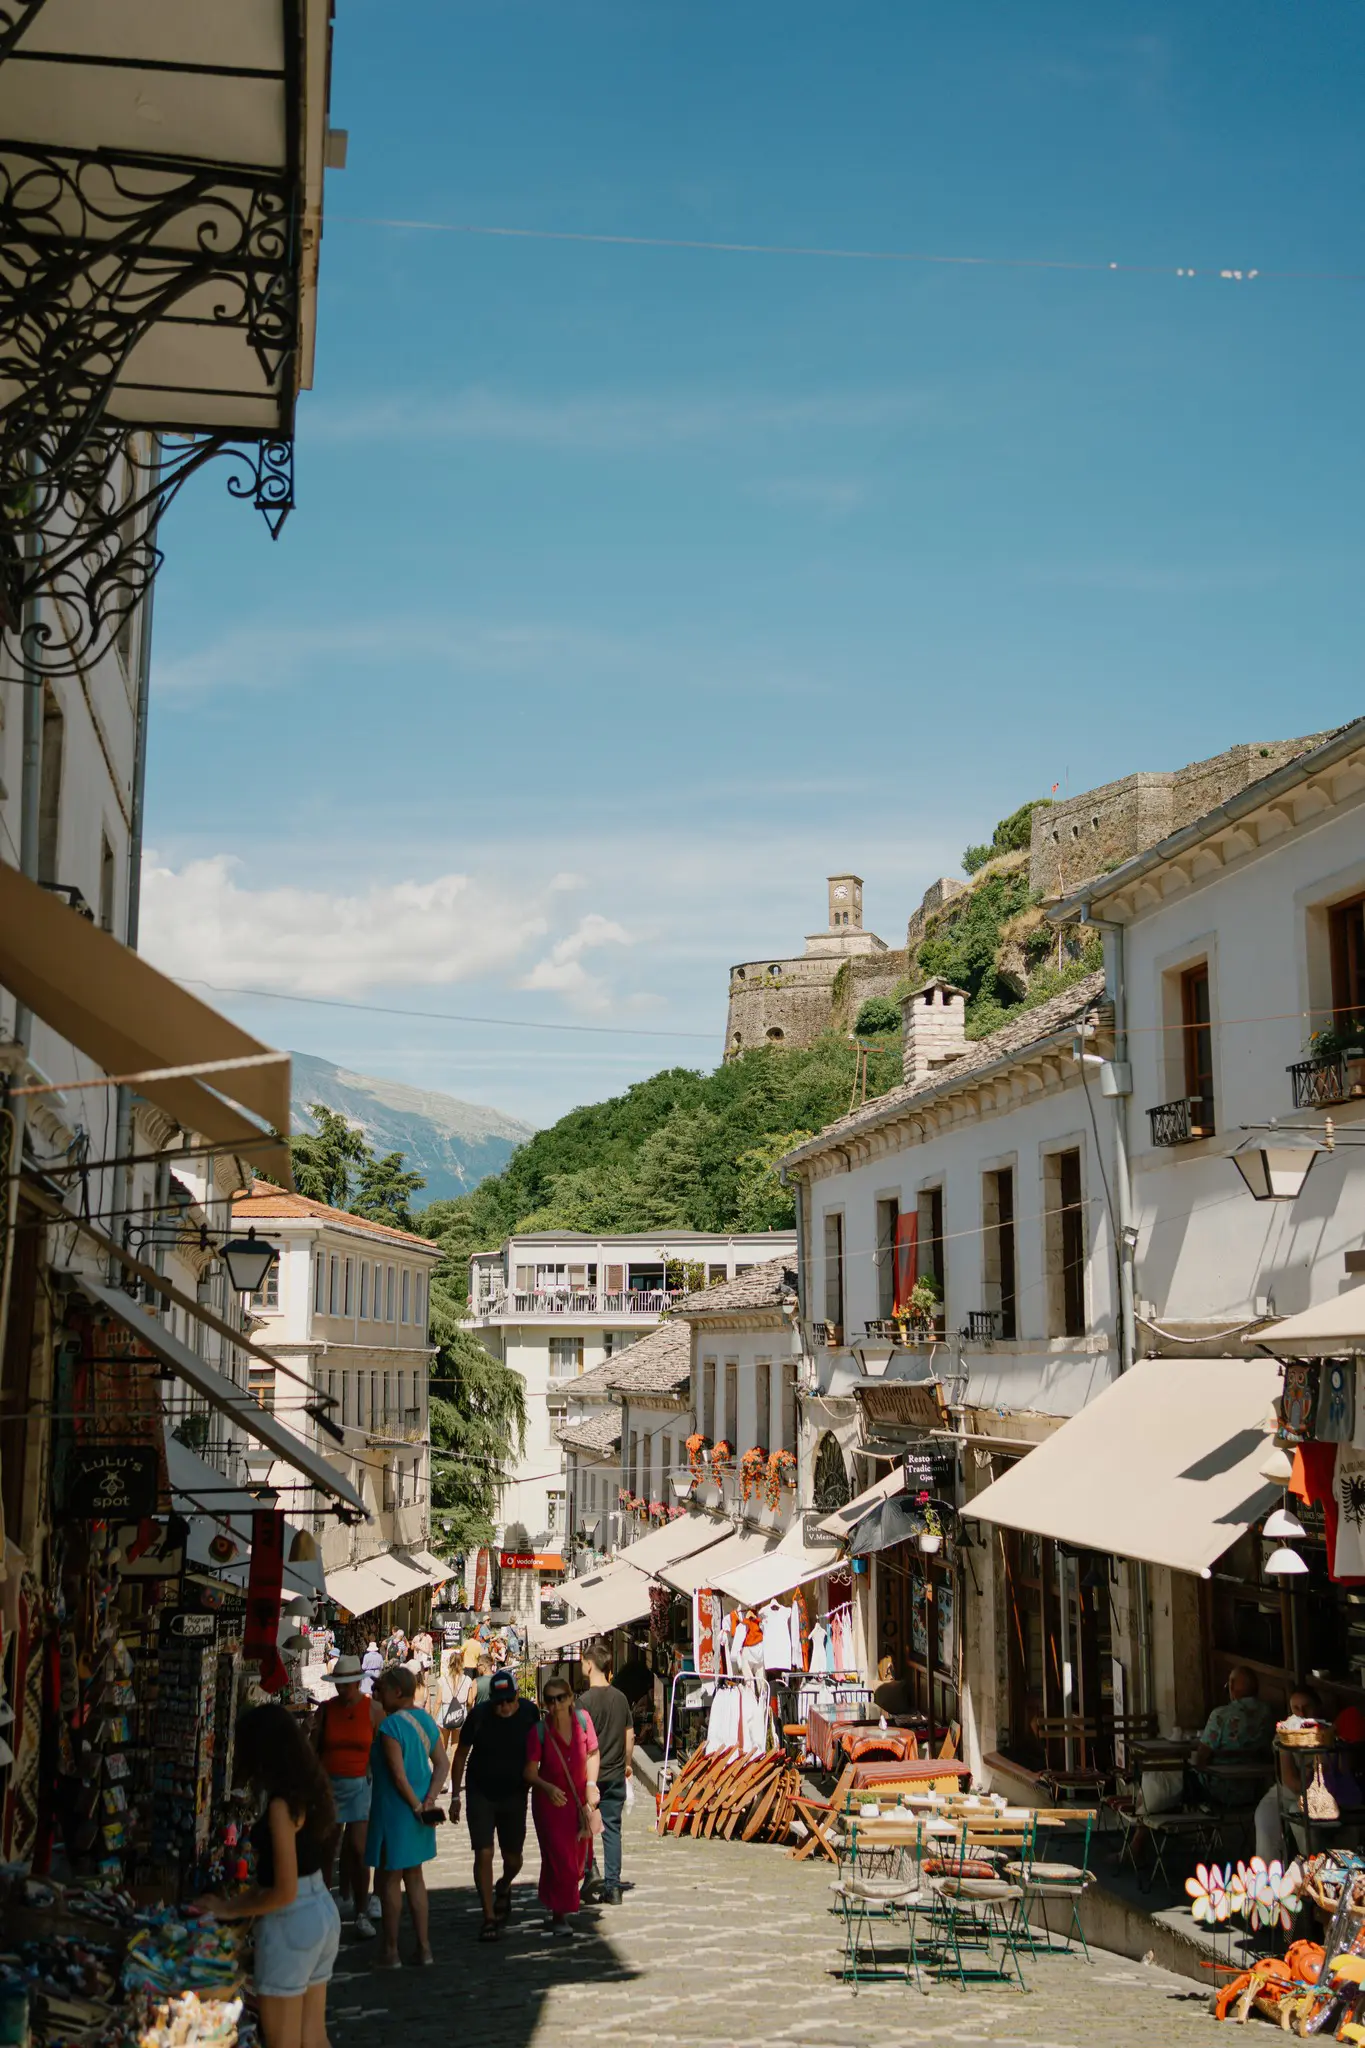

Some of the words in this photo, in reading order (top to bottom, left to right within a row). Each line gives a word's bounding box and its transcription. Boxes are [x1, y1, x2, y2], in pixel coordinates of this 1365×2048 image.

[92, 1496, 131, 1509] spot
[184, 1624, 201, 1634] 200
[444, 1621, 462, 1629] HOTEL
